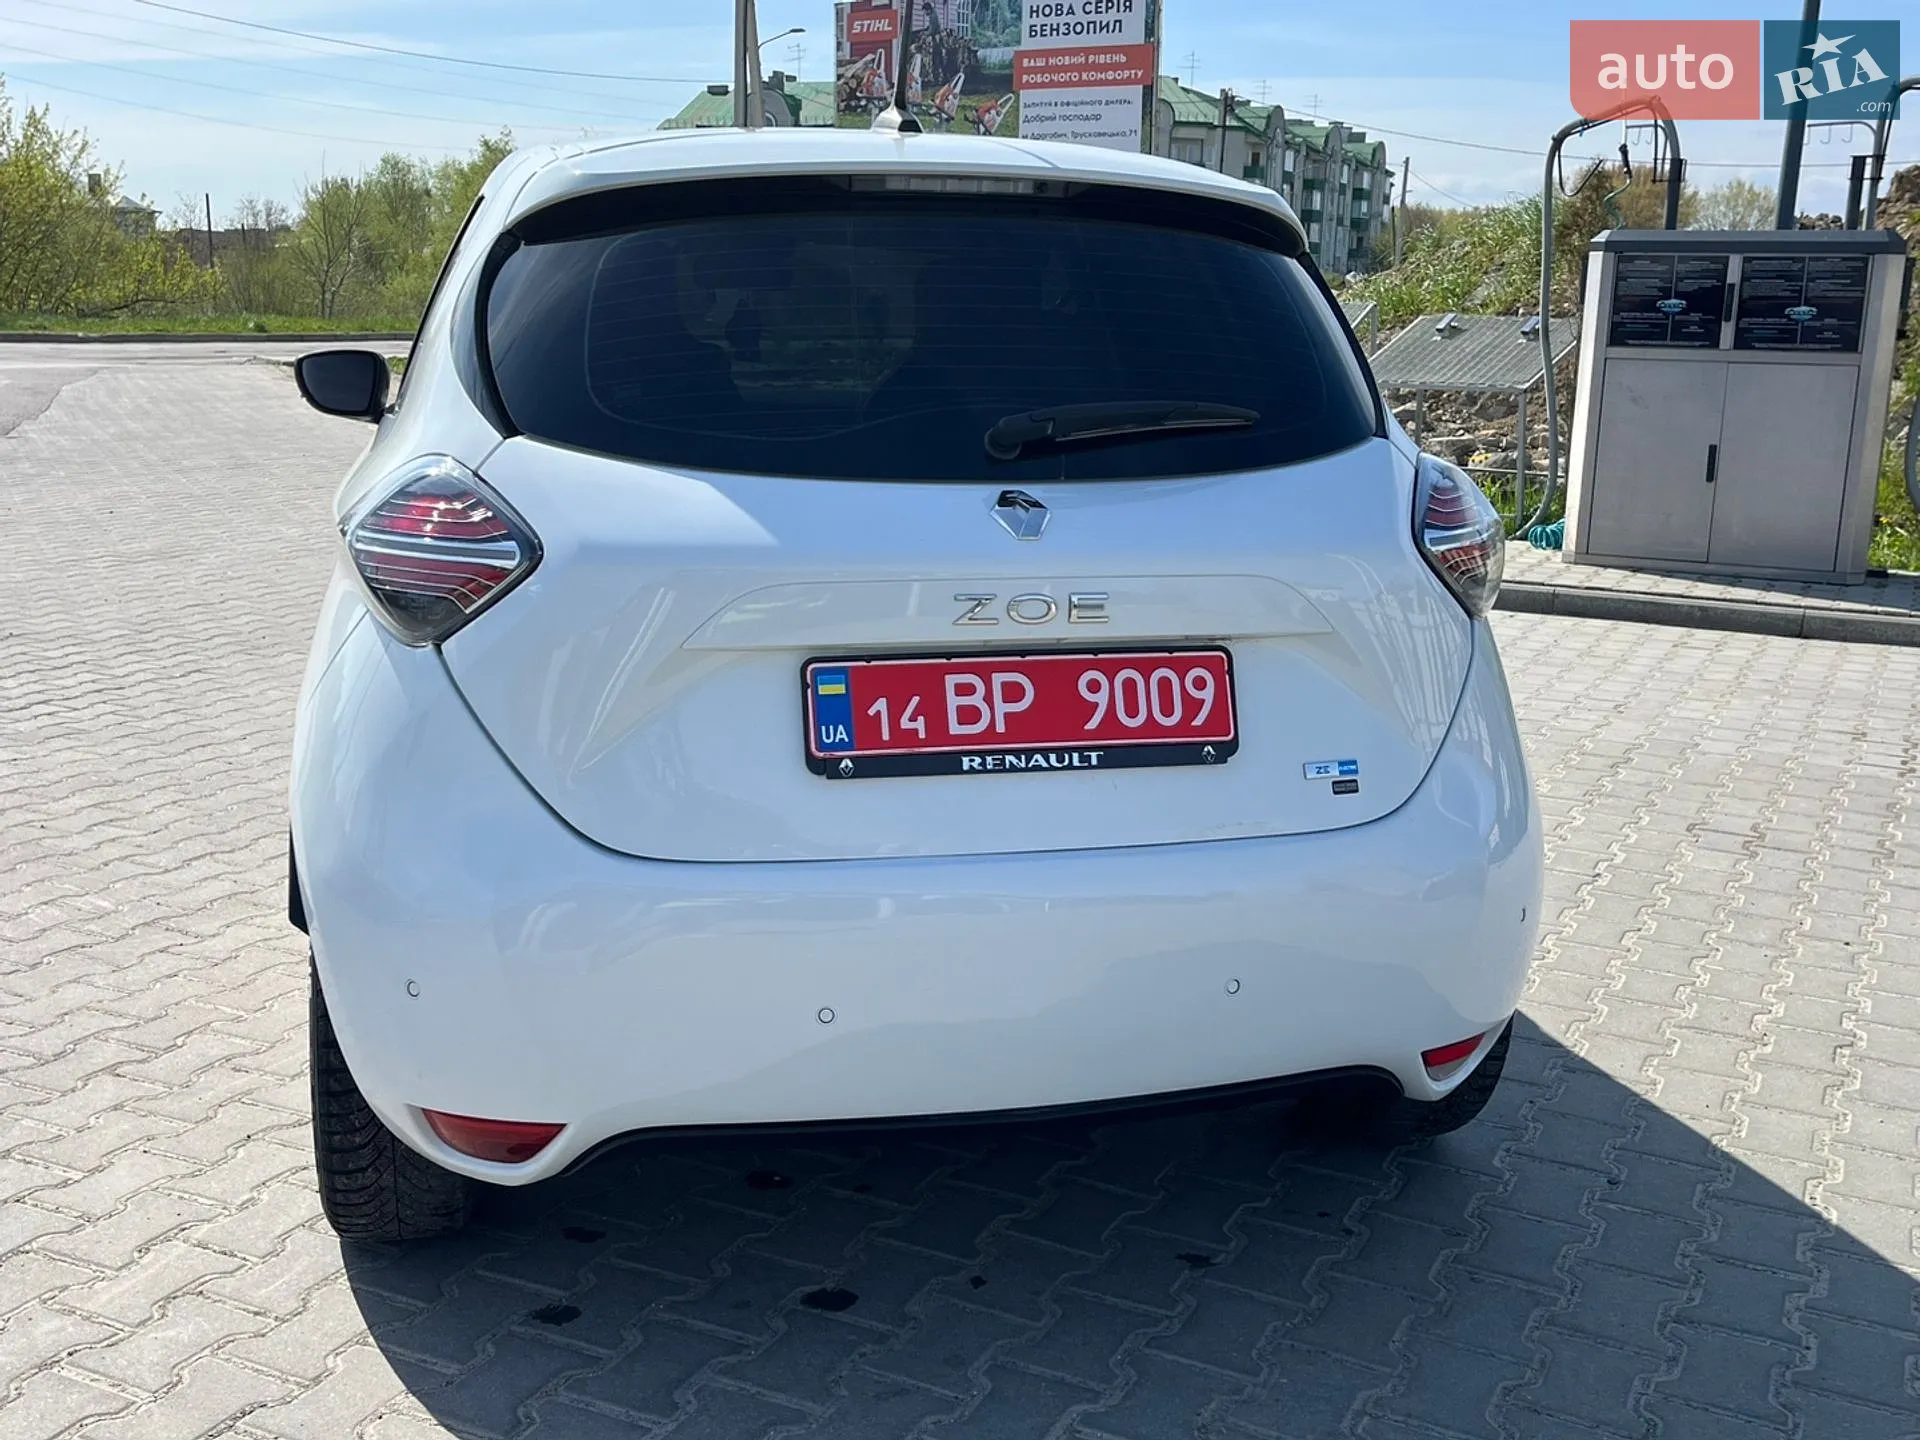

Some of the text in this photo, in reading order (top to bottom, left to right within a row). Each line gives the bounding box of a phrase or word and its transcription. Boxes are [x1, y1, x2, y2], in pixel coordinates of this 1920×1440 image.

[1029, 0, 1133, 19] НОВА СЕРІЯ
[852, 19, 892, 33] STIHL
[1029, 20, 1122, 38] БЕНЗОПИЛ
[1022, 53, 1127, 67] ВАШ НОВИЙ РІВЕНЬ
[1022, 69, 1144, 83] РОБОЧОГО КОМФОРТУ
[1022, 112, 1057, 124] Добрий
[952, 592, 1110, 626] ZOE
[867, 667, 1215, 741] 14 BP 9009
[821, 725, 849, 744] UA
[960, 751, 1104, 771] RENAULT
